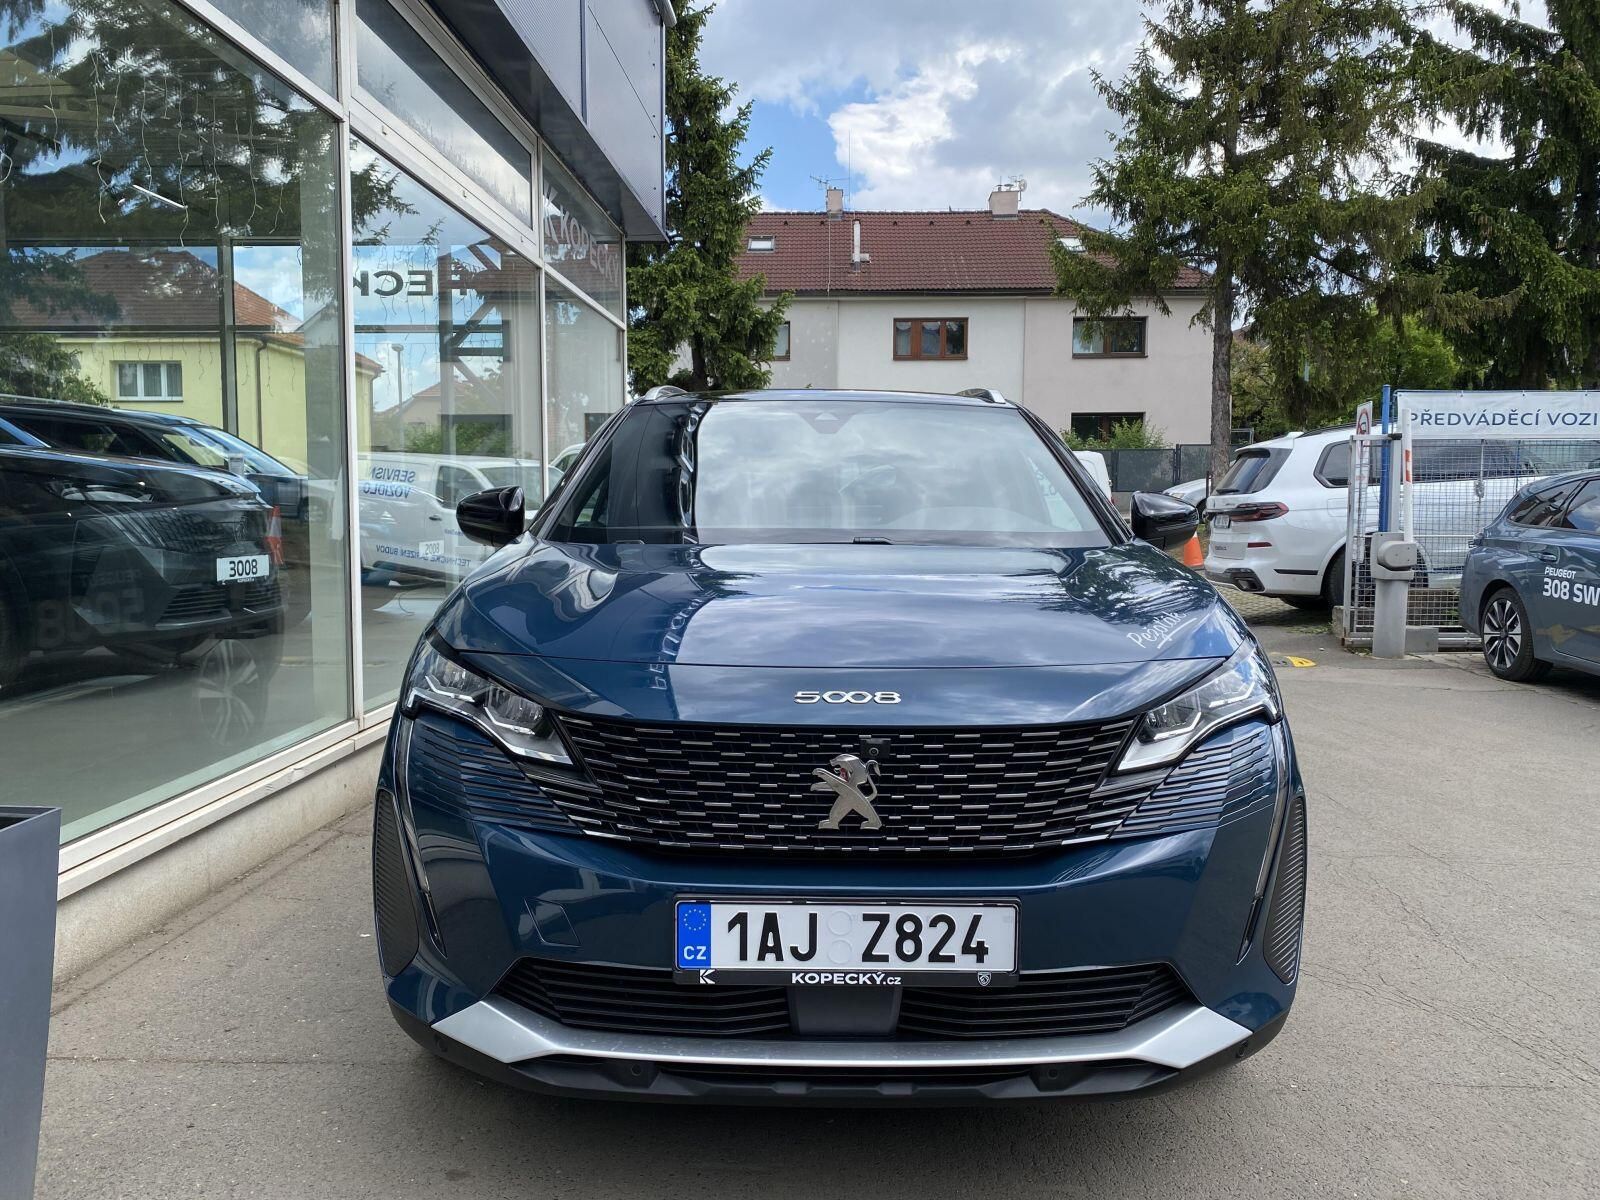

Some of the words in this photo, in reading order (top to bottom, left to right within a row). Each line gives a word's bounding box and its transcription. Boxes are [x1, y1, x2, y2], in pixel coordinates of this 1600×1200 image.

[1547, 412, 1598, 426] VOZI
[228, 559, 258, 577] 3008
[1544, 566, 1577, 580] PEUGEOT
[1542, 577, 1570, 600] 308
[1573, 583, 1600, 607] SW
[793, 690, 902, 705] 5008
[727, 911, 819, 962] 1AJ
[861, 912, 989, 963] Z824
[683, 945, 707, 960] CZ
